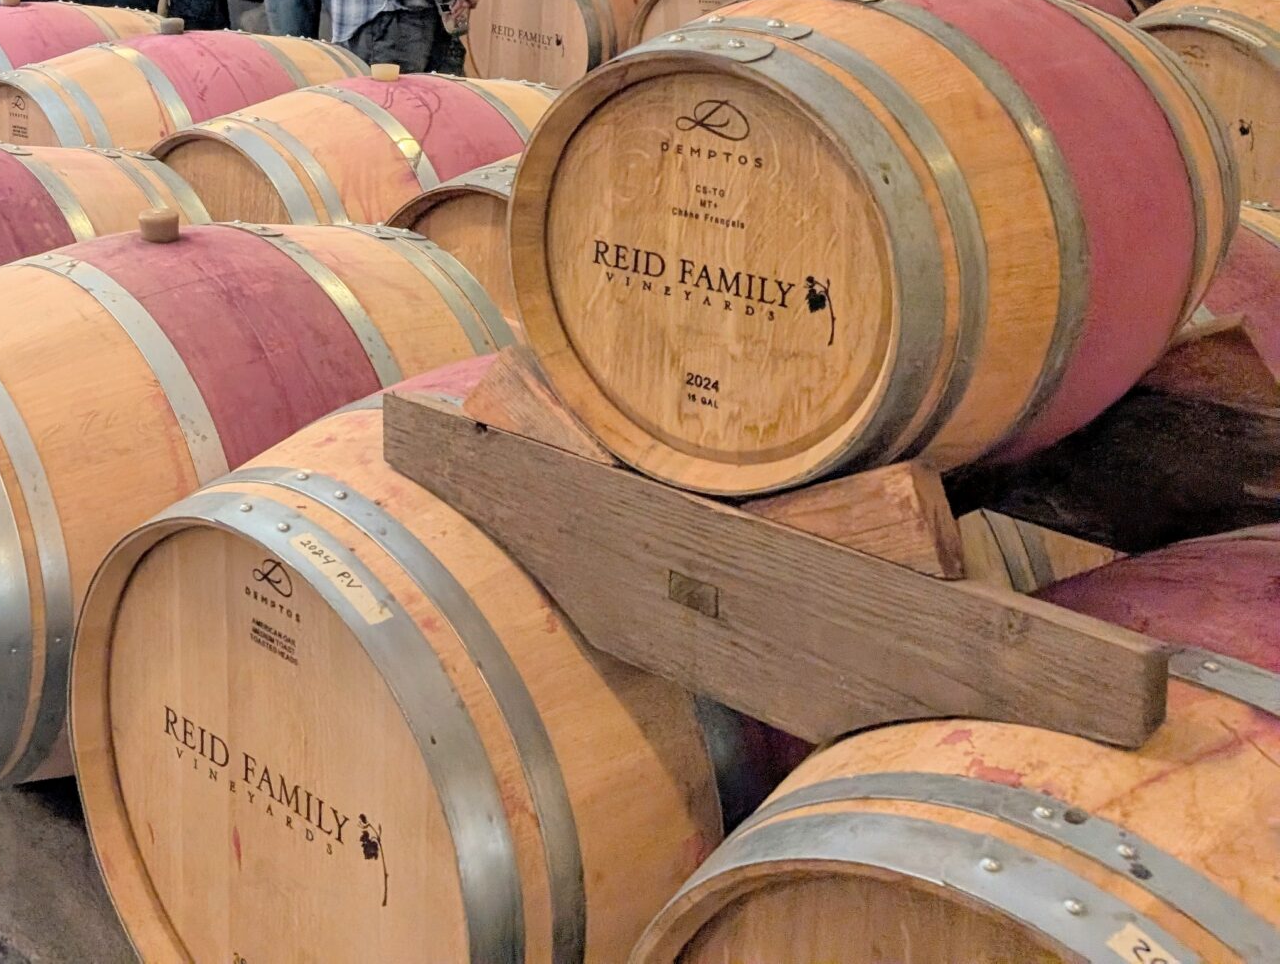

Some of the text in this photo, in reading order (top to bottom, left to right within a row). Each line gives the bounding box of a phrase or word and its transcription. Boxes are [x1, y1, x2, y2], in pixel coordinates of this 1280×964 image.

[491, 23, 553, 46] REID FAMILY
[660, 141, 763, 169] DEMPTOS
[592, 239, 796, 308] REID FAMILY
[606, 271, 776, 321] VINEYARDS
[685, 372, 720, 393] 2024
[300, 540, 336, 564] 2024
[164, 705, 350, 845] REID FAMILY
[175, 746, 333, 855] VINEYARDS
